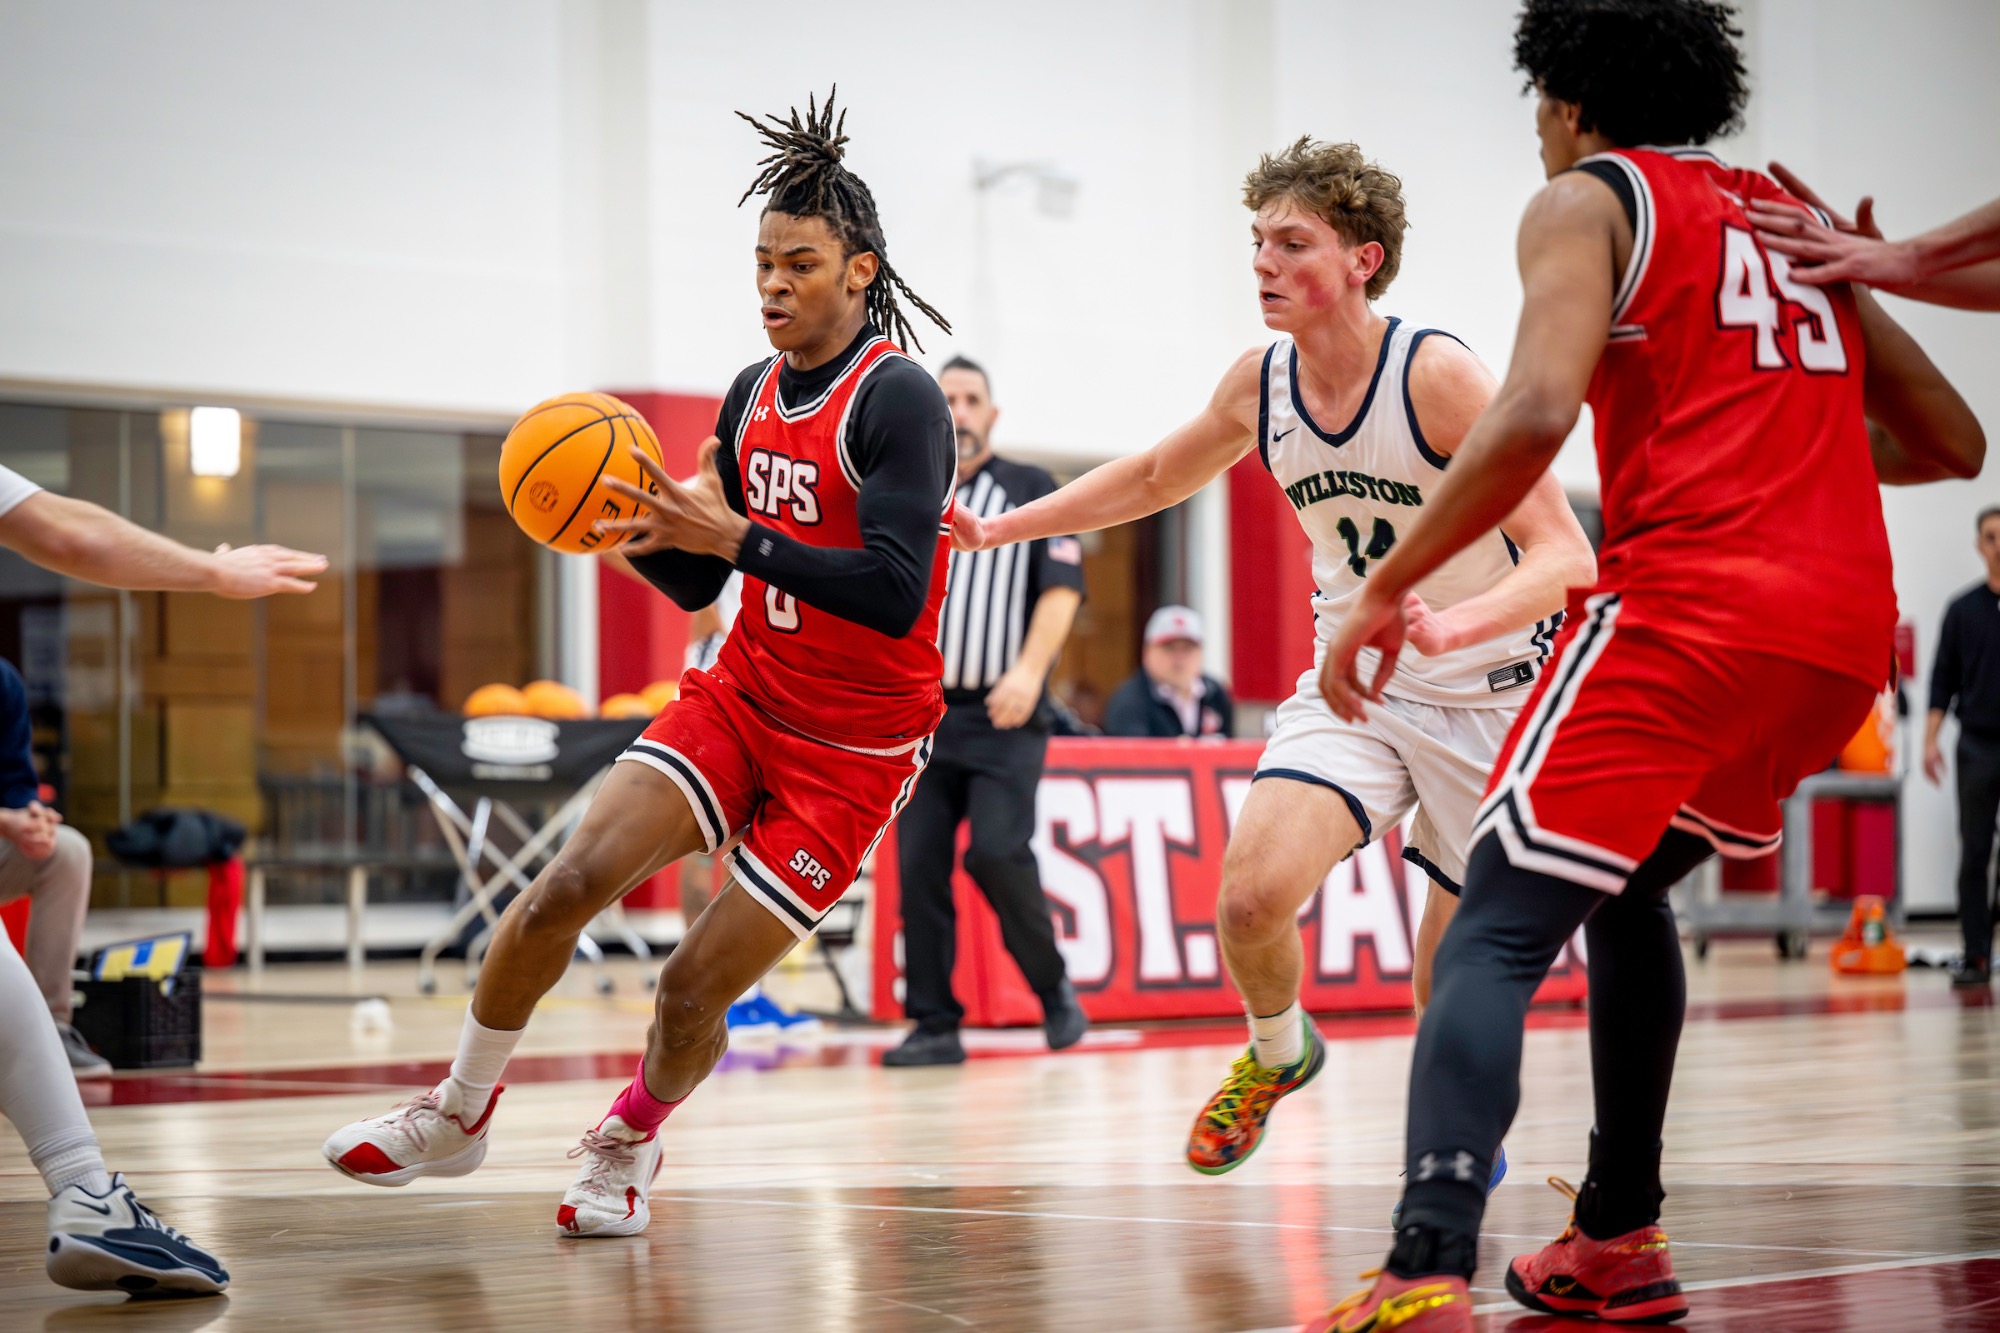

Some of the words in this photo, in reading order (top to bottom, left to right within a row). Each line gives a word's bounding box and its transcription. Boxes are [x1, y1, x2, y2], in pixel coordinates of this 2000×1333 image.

[1714, 220, 1848, 376] 45
[746, 447, 823, 526] SPS
[1285, 470, 1423, 511] WILLISTON
[788, 847, 832, 891] SPS
[1028, 768, 1221, 990] ST.
